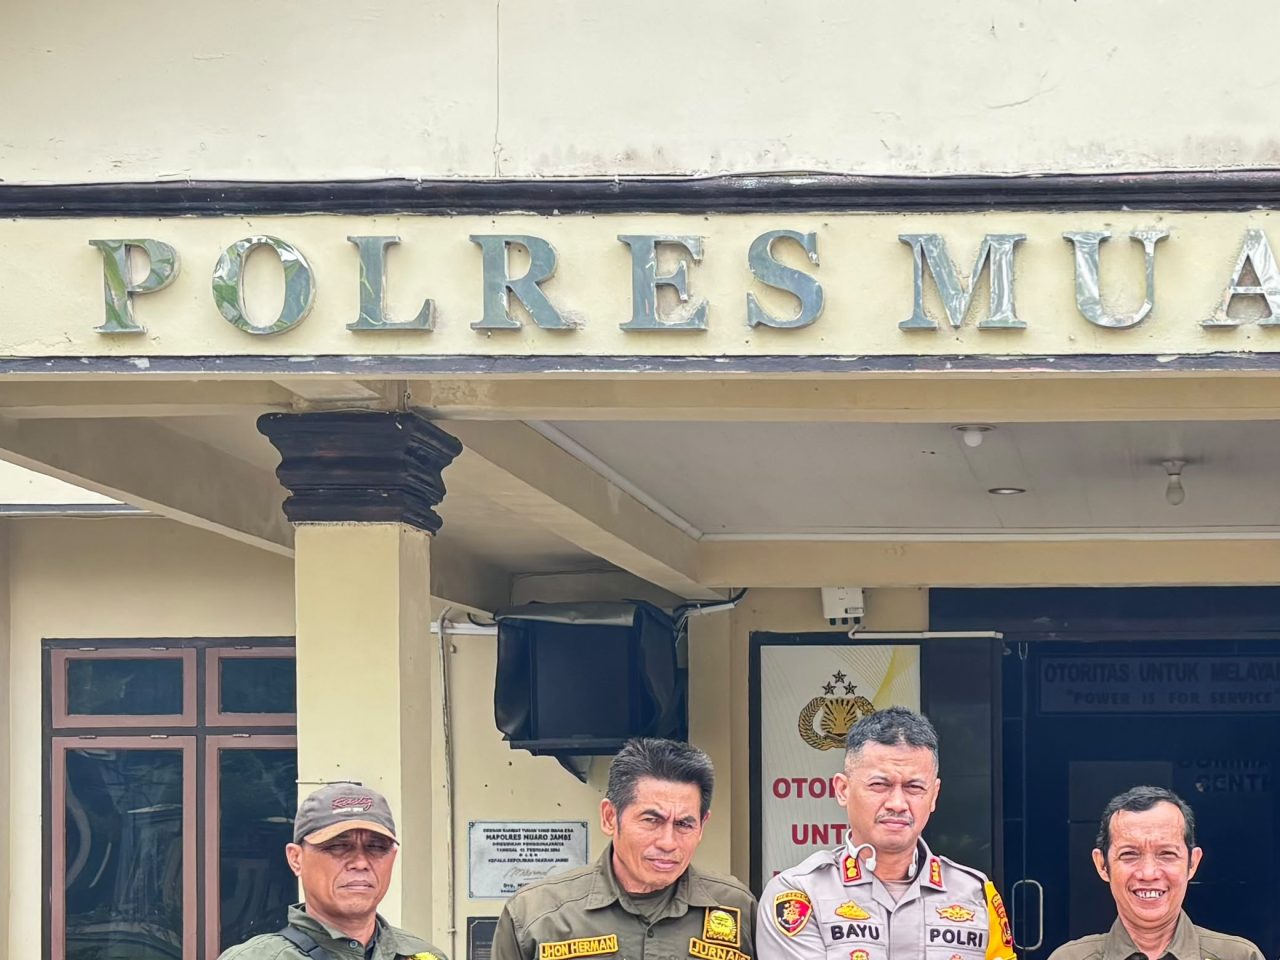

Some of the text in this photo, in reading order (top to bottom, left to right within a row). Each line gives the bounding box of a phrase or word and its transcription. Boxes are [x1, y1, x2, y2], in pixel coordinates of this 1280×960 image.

[88, 228, 826, 336] POLRES
[1044, 662, 1130, 684] OTORITAS
[1140, 662, 1198, 683] UNTUK
[1142, 692, 1154, 704] IS
[1169, 692, 1198, 704] FOR
[792, 824, 852, 845] UNT
[830, 923, 880, 940] BAYU
[930, 928, 983, 948] POLRI
[542, 937, 616, 958] JHON HERMAN
